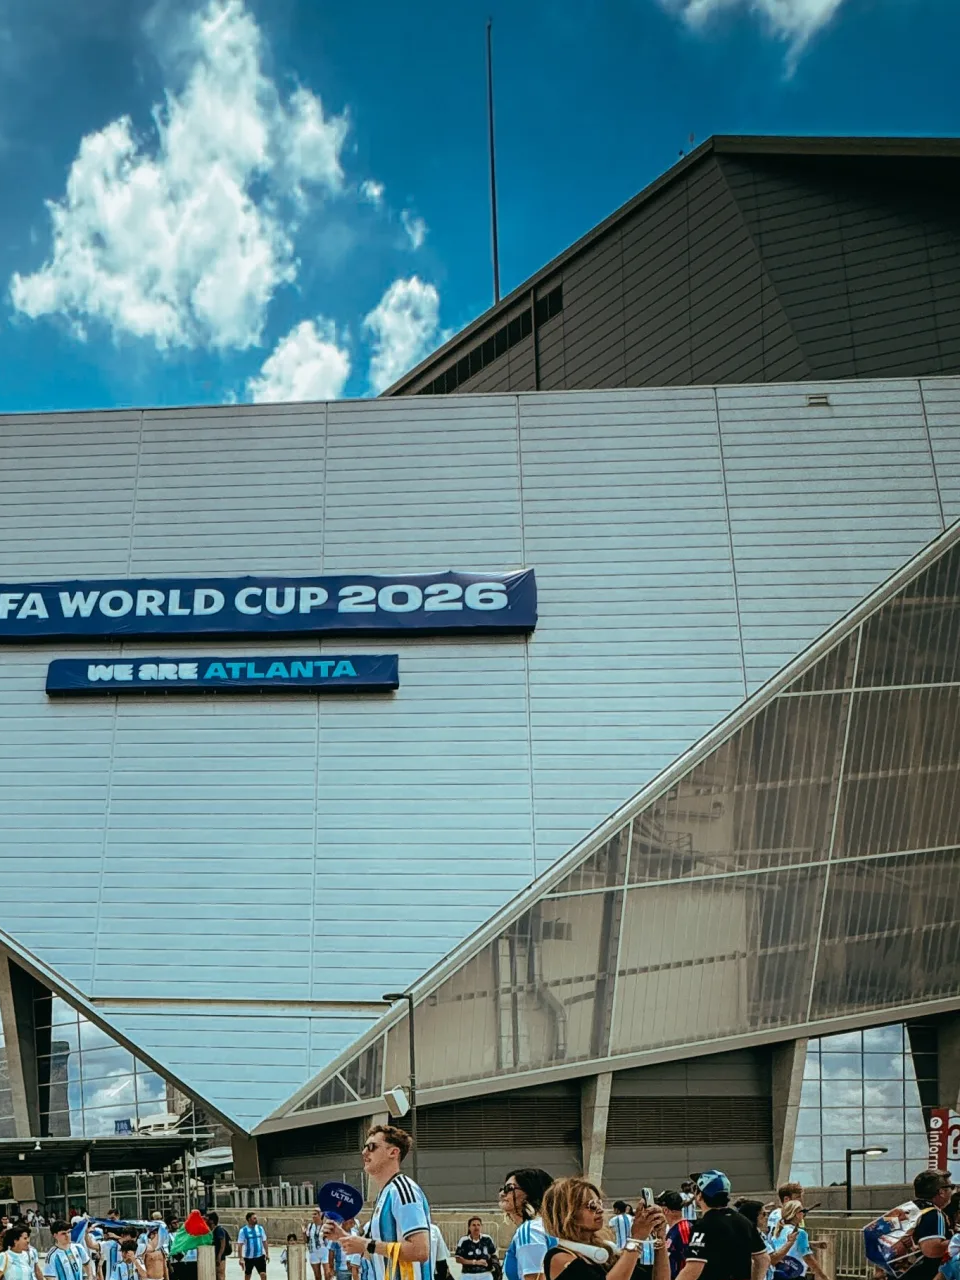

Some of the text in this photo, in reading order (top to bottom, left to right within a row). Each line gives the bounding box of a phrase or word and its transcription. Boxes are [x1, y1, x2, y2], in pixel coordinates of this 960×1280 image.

[58, 588, 225, 618] WORLD
[234, 586, 329, 615] CUP
[337, 582, 509, 613] 2026
[87, 660, 358, 682] WE ARE ATLANTA
[330, 1190, 354, 1205] ULTRA
